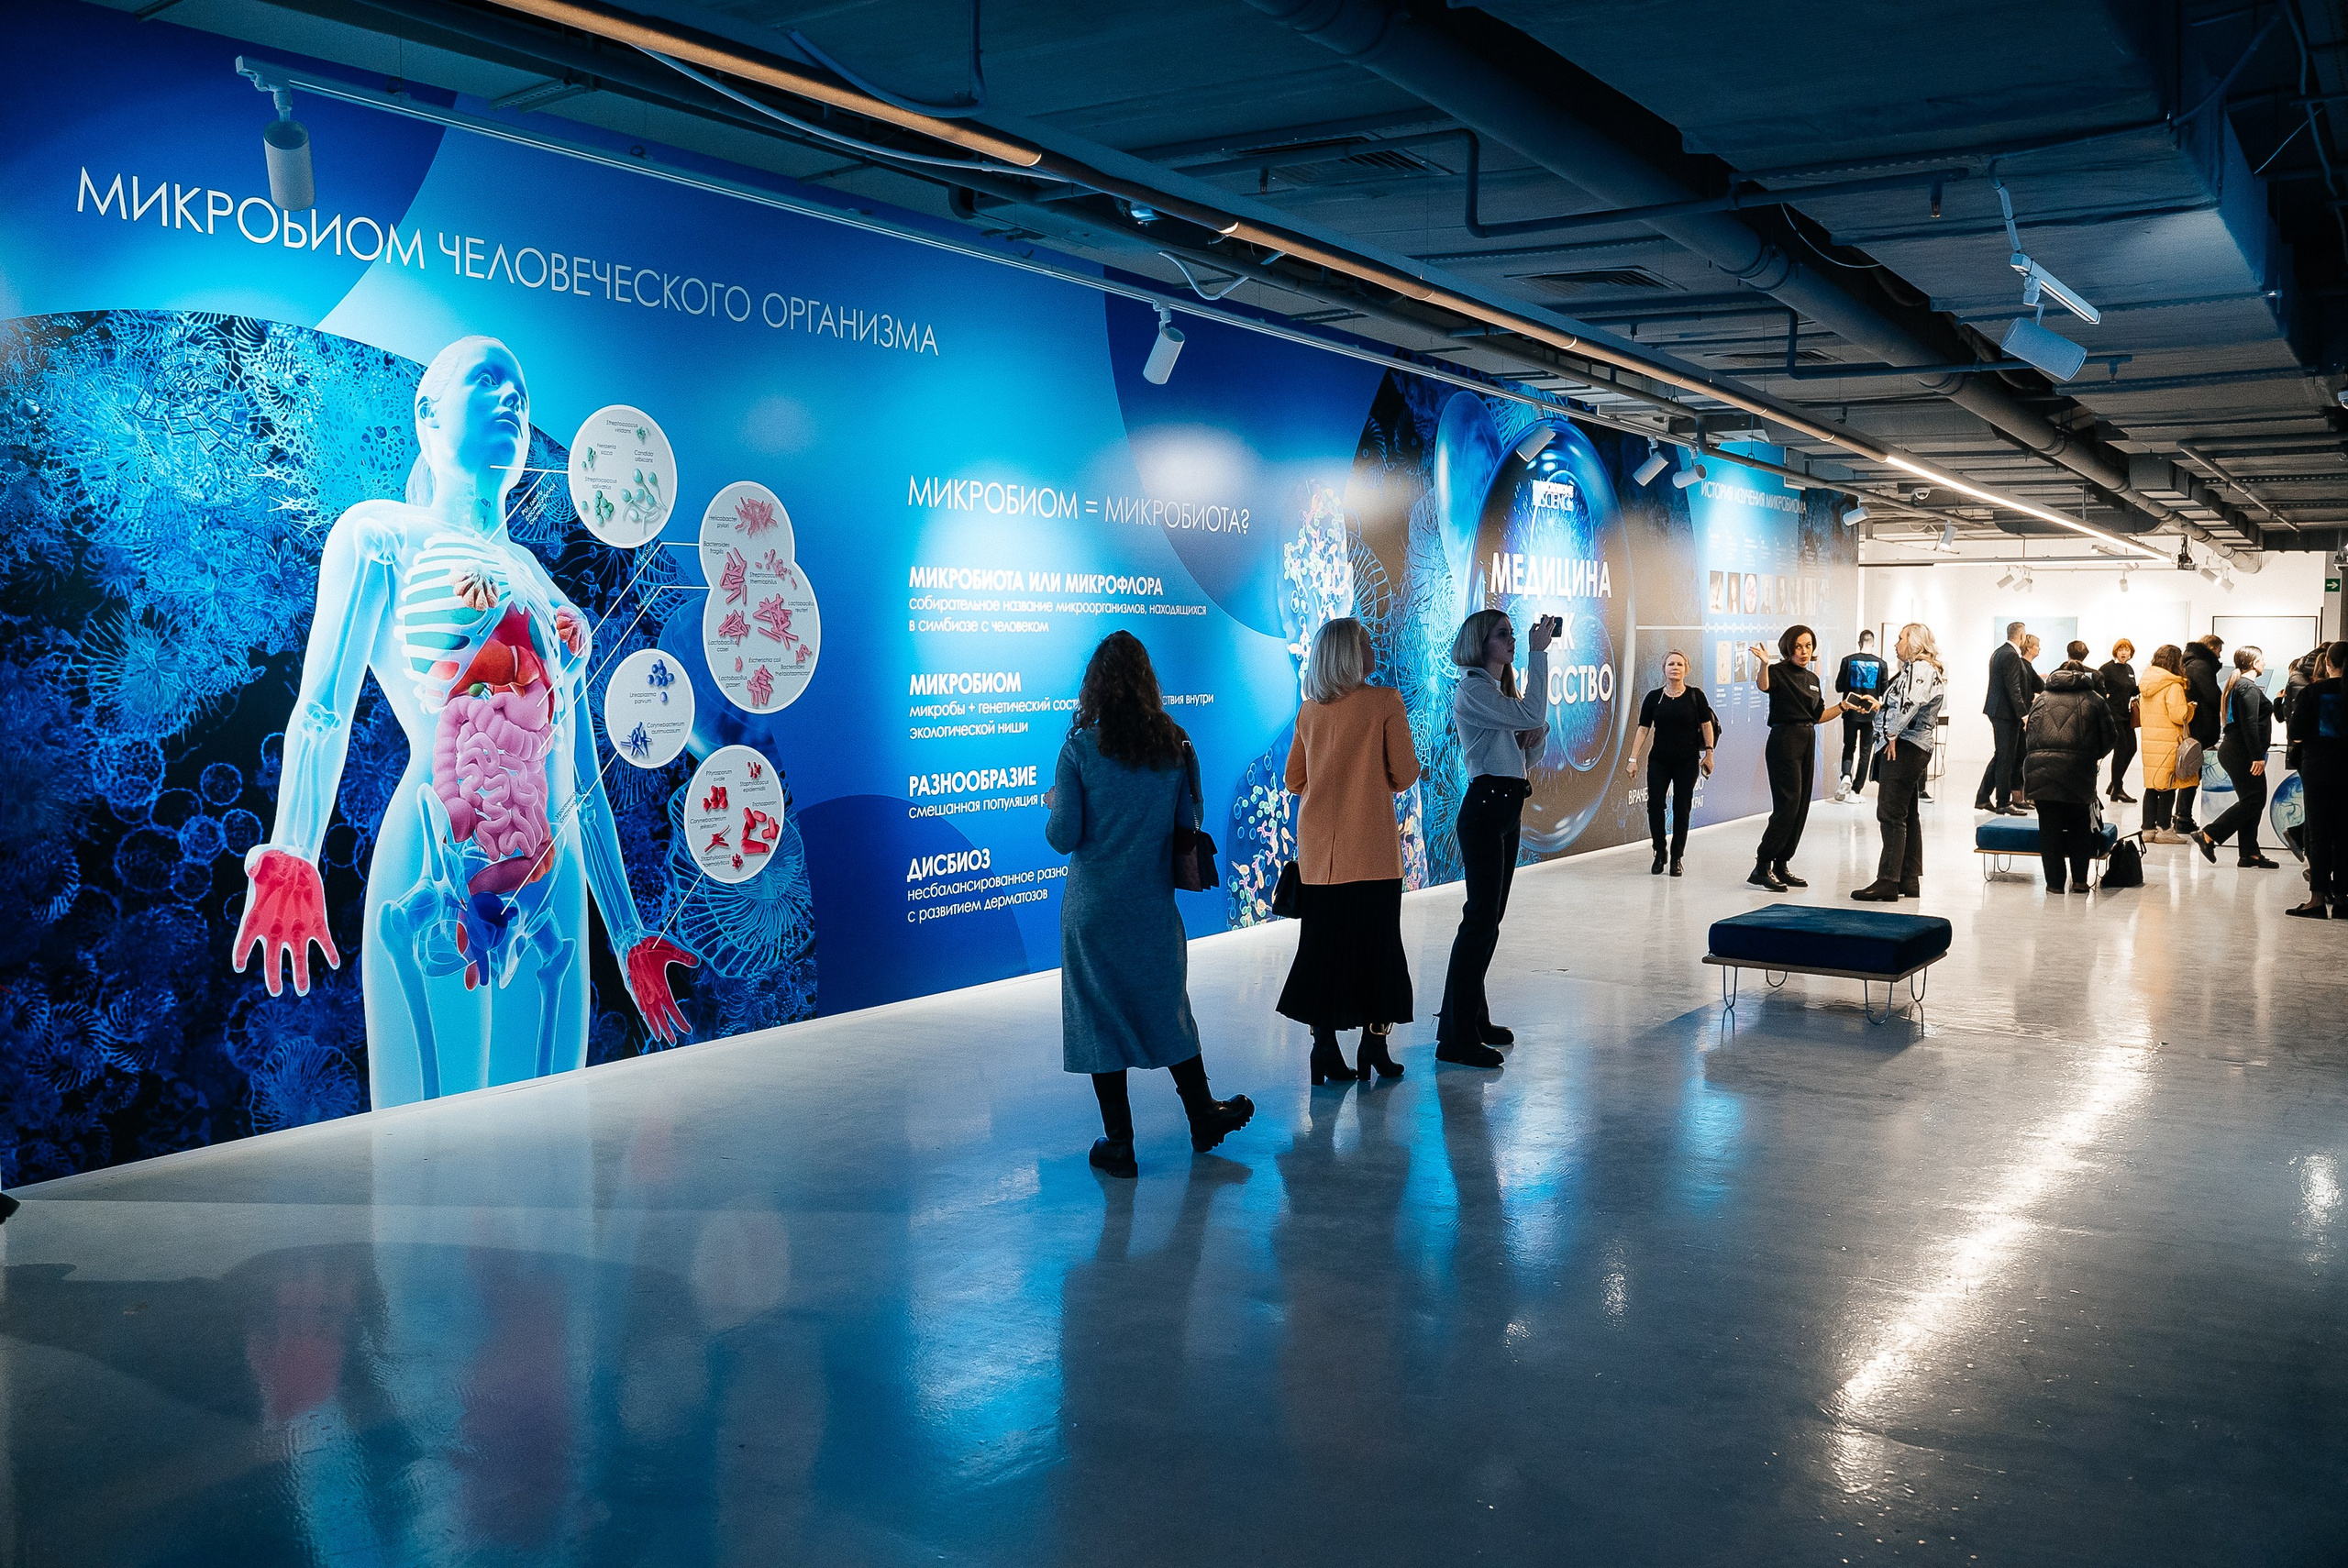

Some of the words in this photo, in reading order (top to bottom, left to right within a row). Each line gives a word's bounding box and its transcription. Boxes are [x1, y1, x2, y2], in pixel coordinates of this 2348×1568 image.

[77, 166, 425, 270] МИКРОБИОМ
[438, 231, 751, 323] ЧЕЛОВЕЧЕСКОГО
[762, 292, 939, 356] ОРГАНИЗМА
[908, 474, 1078, 520] МИКРОБИОМ
[1105, 495, 1250, 535] МИКРОБИОТА?
[909, 566, 1024, 592] МИКРОБИОТА
[1028, 571, 1061, 593] ИЛИ
[1065, 573, 1163, 596] МИКРОФЛОРА
[1490, 552, 1611, 602] МЕДИЦИНА
[909, 596, 1001, 615] собирательное
[1002, 601, 1053, 613] название
[1056, 602, 1147, 618] микроорганизмов,
[1149, 603, 1207, 617] находящихся
[909, 621, 915, 632] в
[918, 617, 979, 634] симбиозе
[980, 621, 989, 633] с
[991, 621, 1049, 634] человеком
[909, 671, 1022, 696] МИКРОБИОМ
[909, 701, 966, 720] микробы
[969, 703, 976, 712] +
[978, 697, 1050, 715] генетический
[1162, 696, 1184, 707] ствия
[1186, 693, 1213, 707] внутри
[909, 722, 996, 741] экологической
[998, 720, 1028, 734] ниши
[909, 765, 1037, 798] РАЗНООБРАЗИЕ
[908, 801, 980, 819] смешанная
[982, 794, 1038, 812] популяция
[906, 847, 991, 882] ДИСБИОЗ
[907, 868, 1036, 901] несбалансированное
[1036, 864, 1069, 884] разно
[907, 911, 915, 923] с
[918, 900, 982, 924] развитием
[983, 887, 1048, 911] дерматозов
